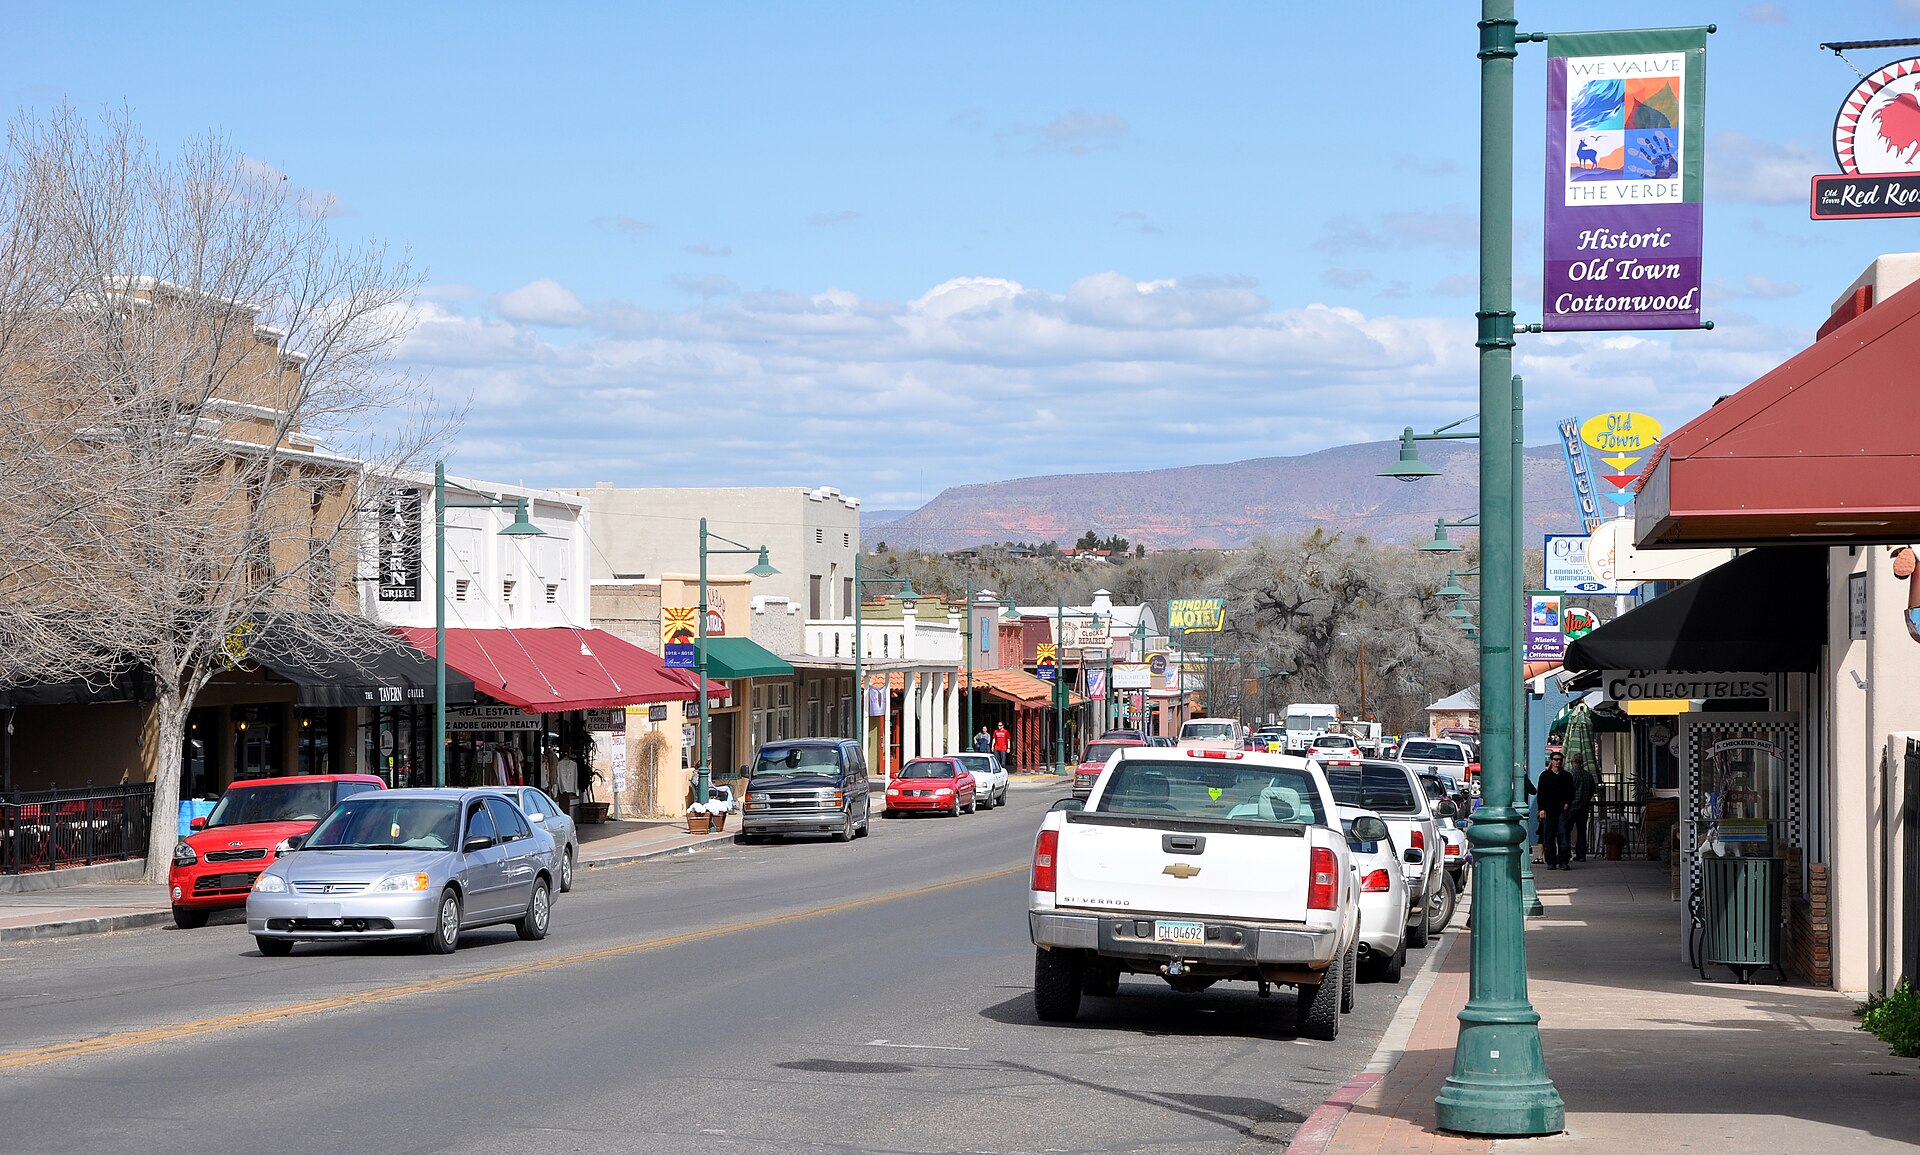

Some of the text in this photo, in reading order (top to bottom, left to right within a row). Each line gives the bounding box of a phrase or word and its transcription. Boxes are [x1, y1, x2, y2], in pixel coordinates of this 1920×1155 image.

[1572, 60, 1680, 75] WE VALUE
[1570, 184, 1679, 200] THE VERDE
[1822, 196, 1840, 204] Town
[1824, 189, 1838, 197] Old
[1841, 184, 1880, 208] Red
[1577, 227, 1672, 250] Historic
[1568, 258, 1680, 281] Old Town
[1555, 287, 1698, 314] Cottonwood
[1606, 413, 1632, 431] Old
[1596, 431, 1641, 449] Town
[1560, 419, 1602, 533] WELCOM
[381, 589, 416, 598] GRILLE
[1583, 583, 1598, 591] 921
[1171, 600, 1219, 610] SUNDIAL
[1170, 610, 1218, 627] MOTEL
[1563, 609, 1595, 634] Vic's
[1079, 637, 1106, 645] REPAIRED
[365, 687, 424, 702] THE TAVERN GRILLE
[1609, 679, 1769, 701] COLLECTIBLES
[459, 708, 520, 716] REAL ESTATE
